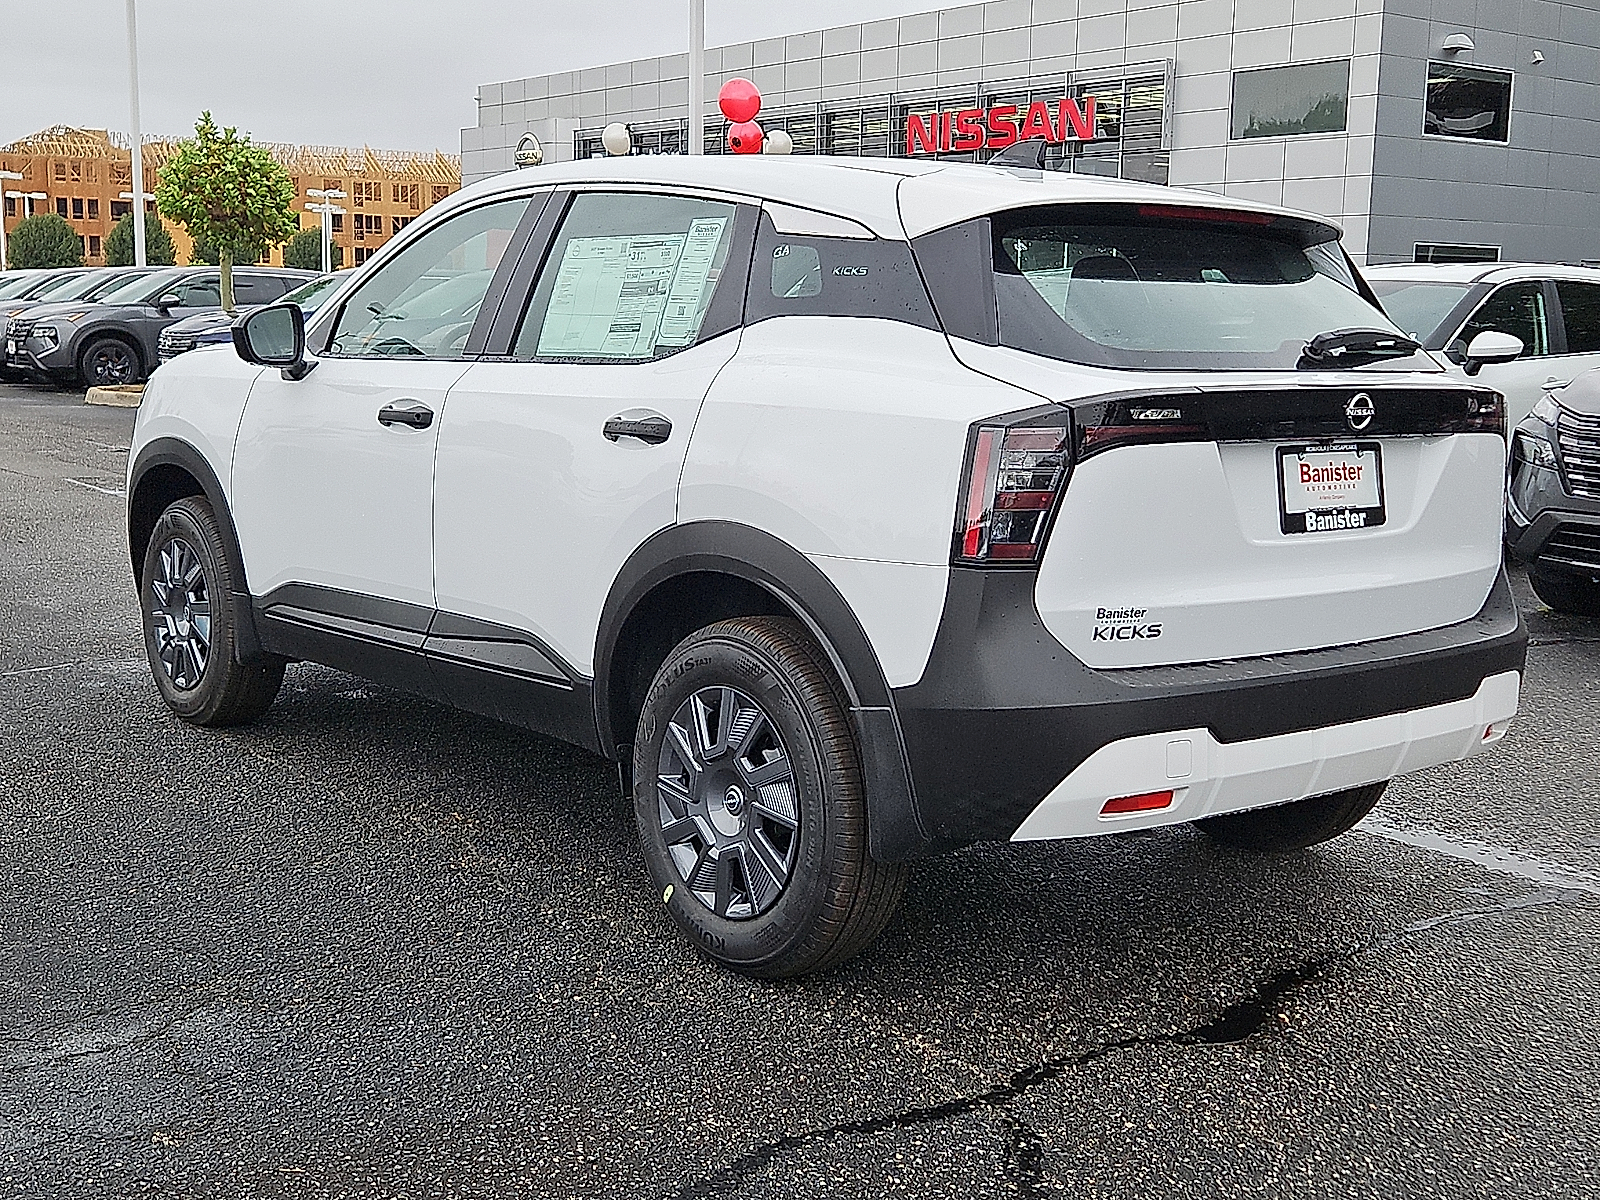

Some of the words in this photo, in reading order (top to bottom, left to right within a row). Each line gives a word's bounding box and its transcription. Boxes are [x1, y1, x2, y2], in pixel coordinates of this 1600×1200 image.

[907, 97, 1096, 155] NISSAN
[832, 265, 869, 276] KICKS
[1346, 408, 1375, 416] NISSAN
[1299, 460, 1363, 484] Banister
[1306, 483, 1356, 492] AUTOMOTIVE
[1305, 509, 1367, 531] Banister
[1097, 607, 1148, 620] Banister
[1092, 624, 1163, 641] KICKS
